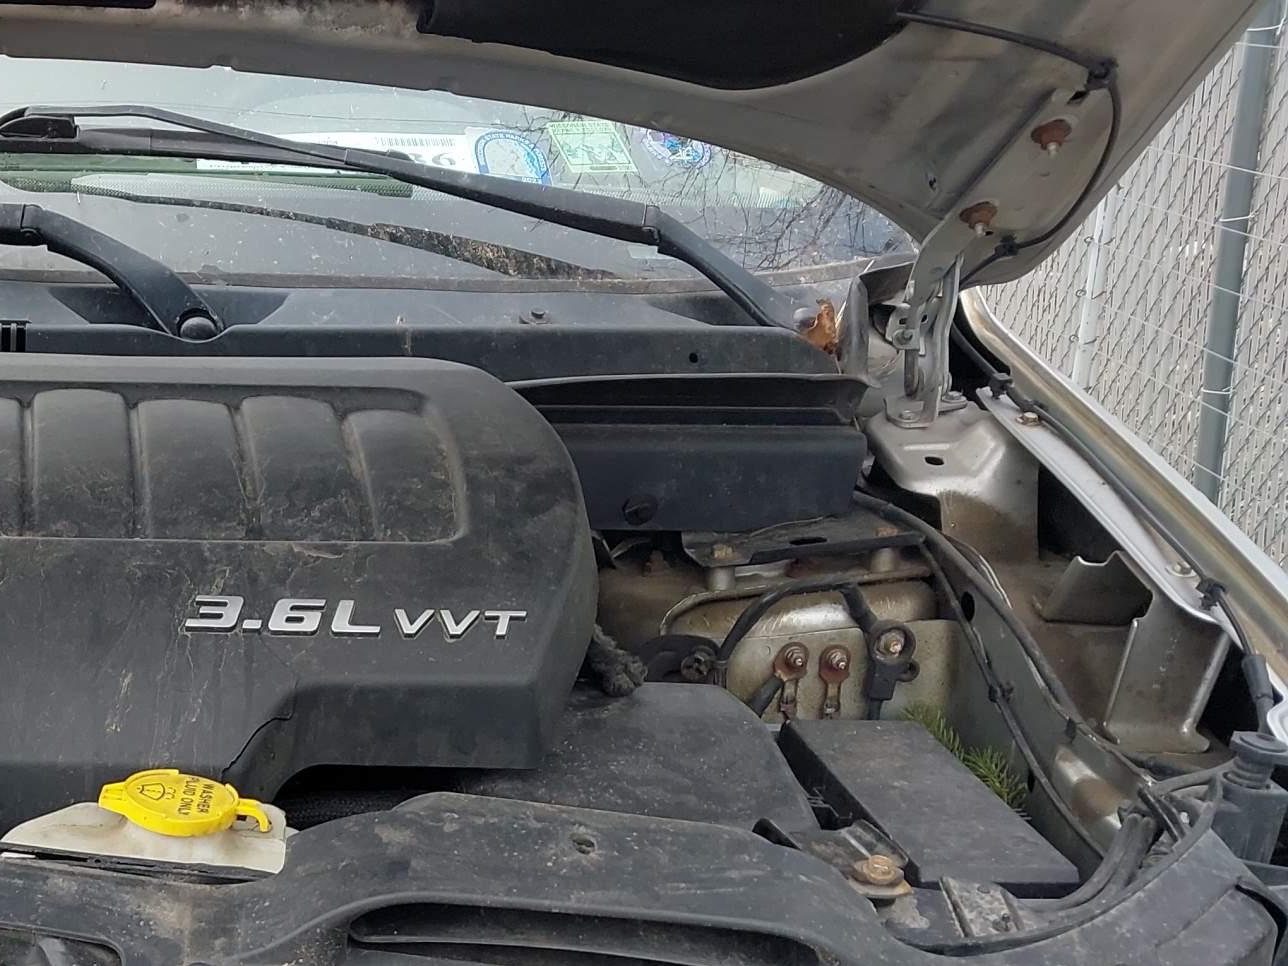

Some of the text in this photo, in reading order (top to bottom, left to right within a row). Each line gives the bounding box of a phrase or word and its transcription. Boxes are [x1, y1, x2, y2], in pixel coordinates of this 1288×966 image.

[184, 594, 528, 640] 3.6L VVT
[197, 783, 215, 815] WASHER
